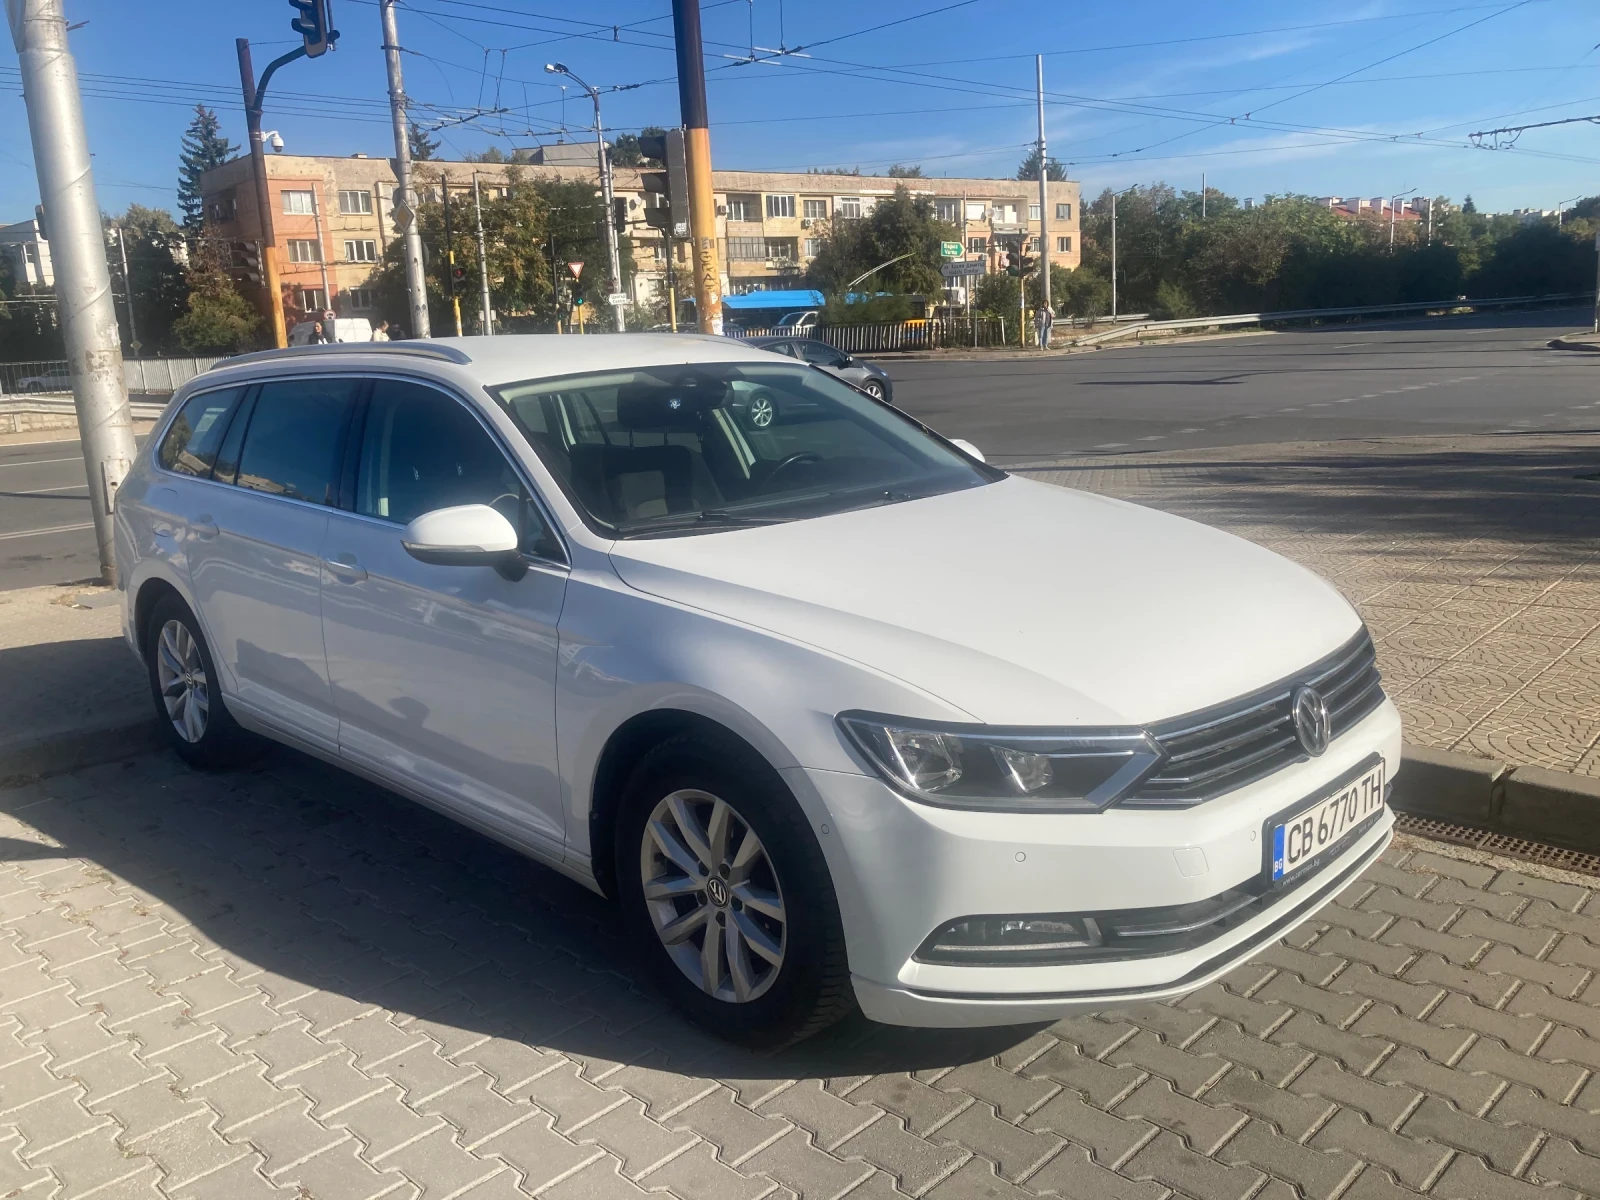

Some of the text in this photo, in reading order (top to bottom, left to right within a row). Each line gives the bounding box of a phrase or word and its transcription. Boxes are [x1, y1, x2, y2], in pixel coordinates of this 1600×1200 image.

[1288, 816, 1313, 864] CB
[1318, 787, 1358, 845] 6770
[1362, 769, 1381, 814] TH
[1274, 858, 1283, 873] BG
